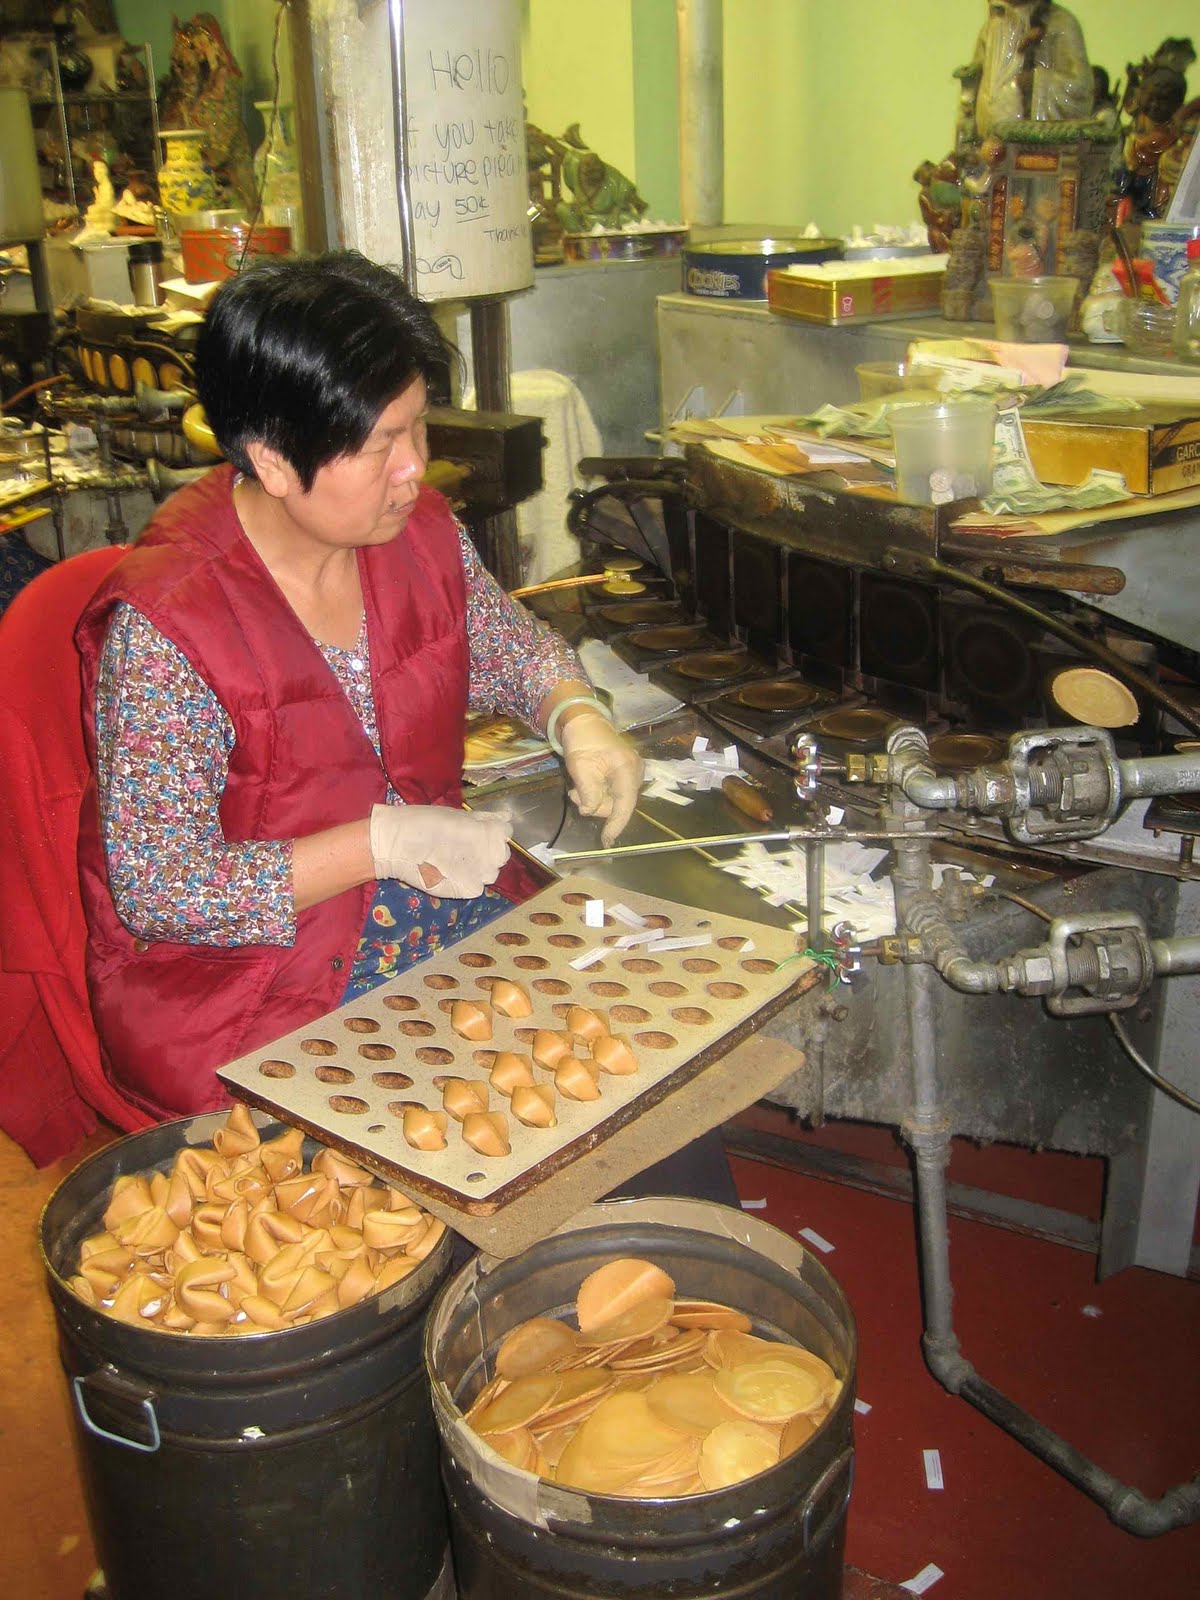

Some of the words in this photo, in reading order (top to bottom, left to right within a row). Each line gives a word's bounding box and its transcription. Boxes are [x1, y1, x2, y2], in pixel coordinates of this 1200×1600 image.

[429, 49, 509, 94] Hello
[434, 119, 475, 162] you
[414, 200, 440, 228] ay
